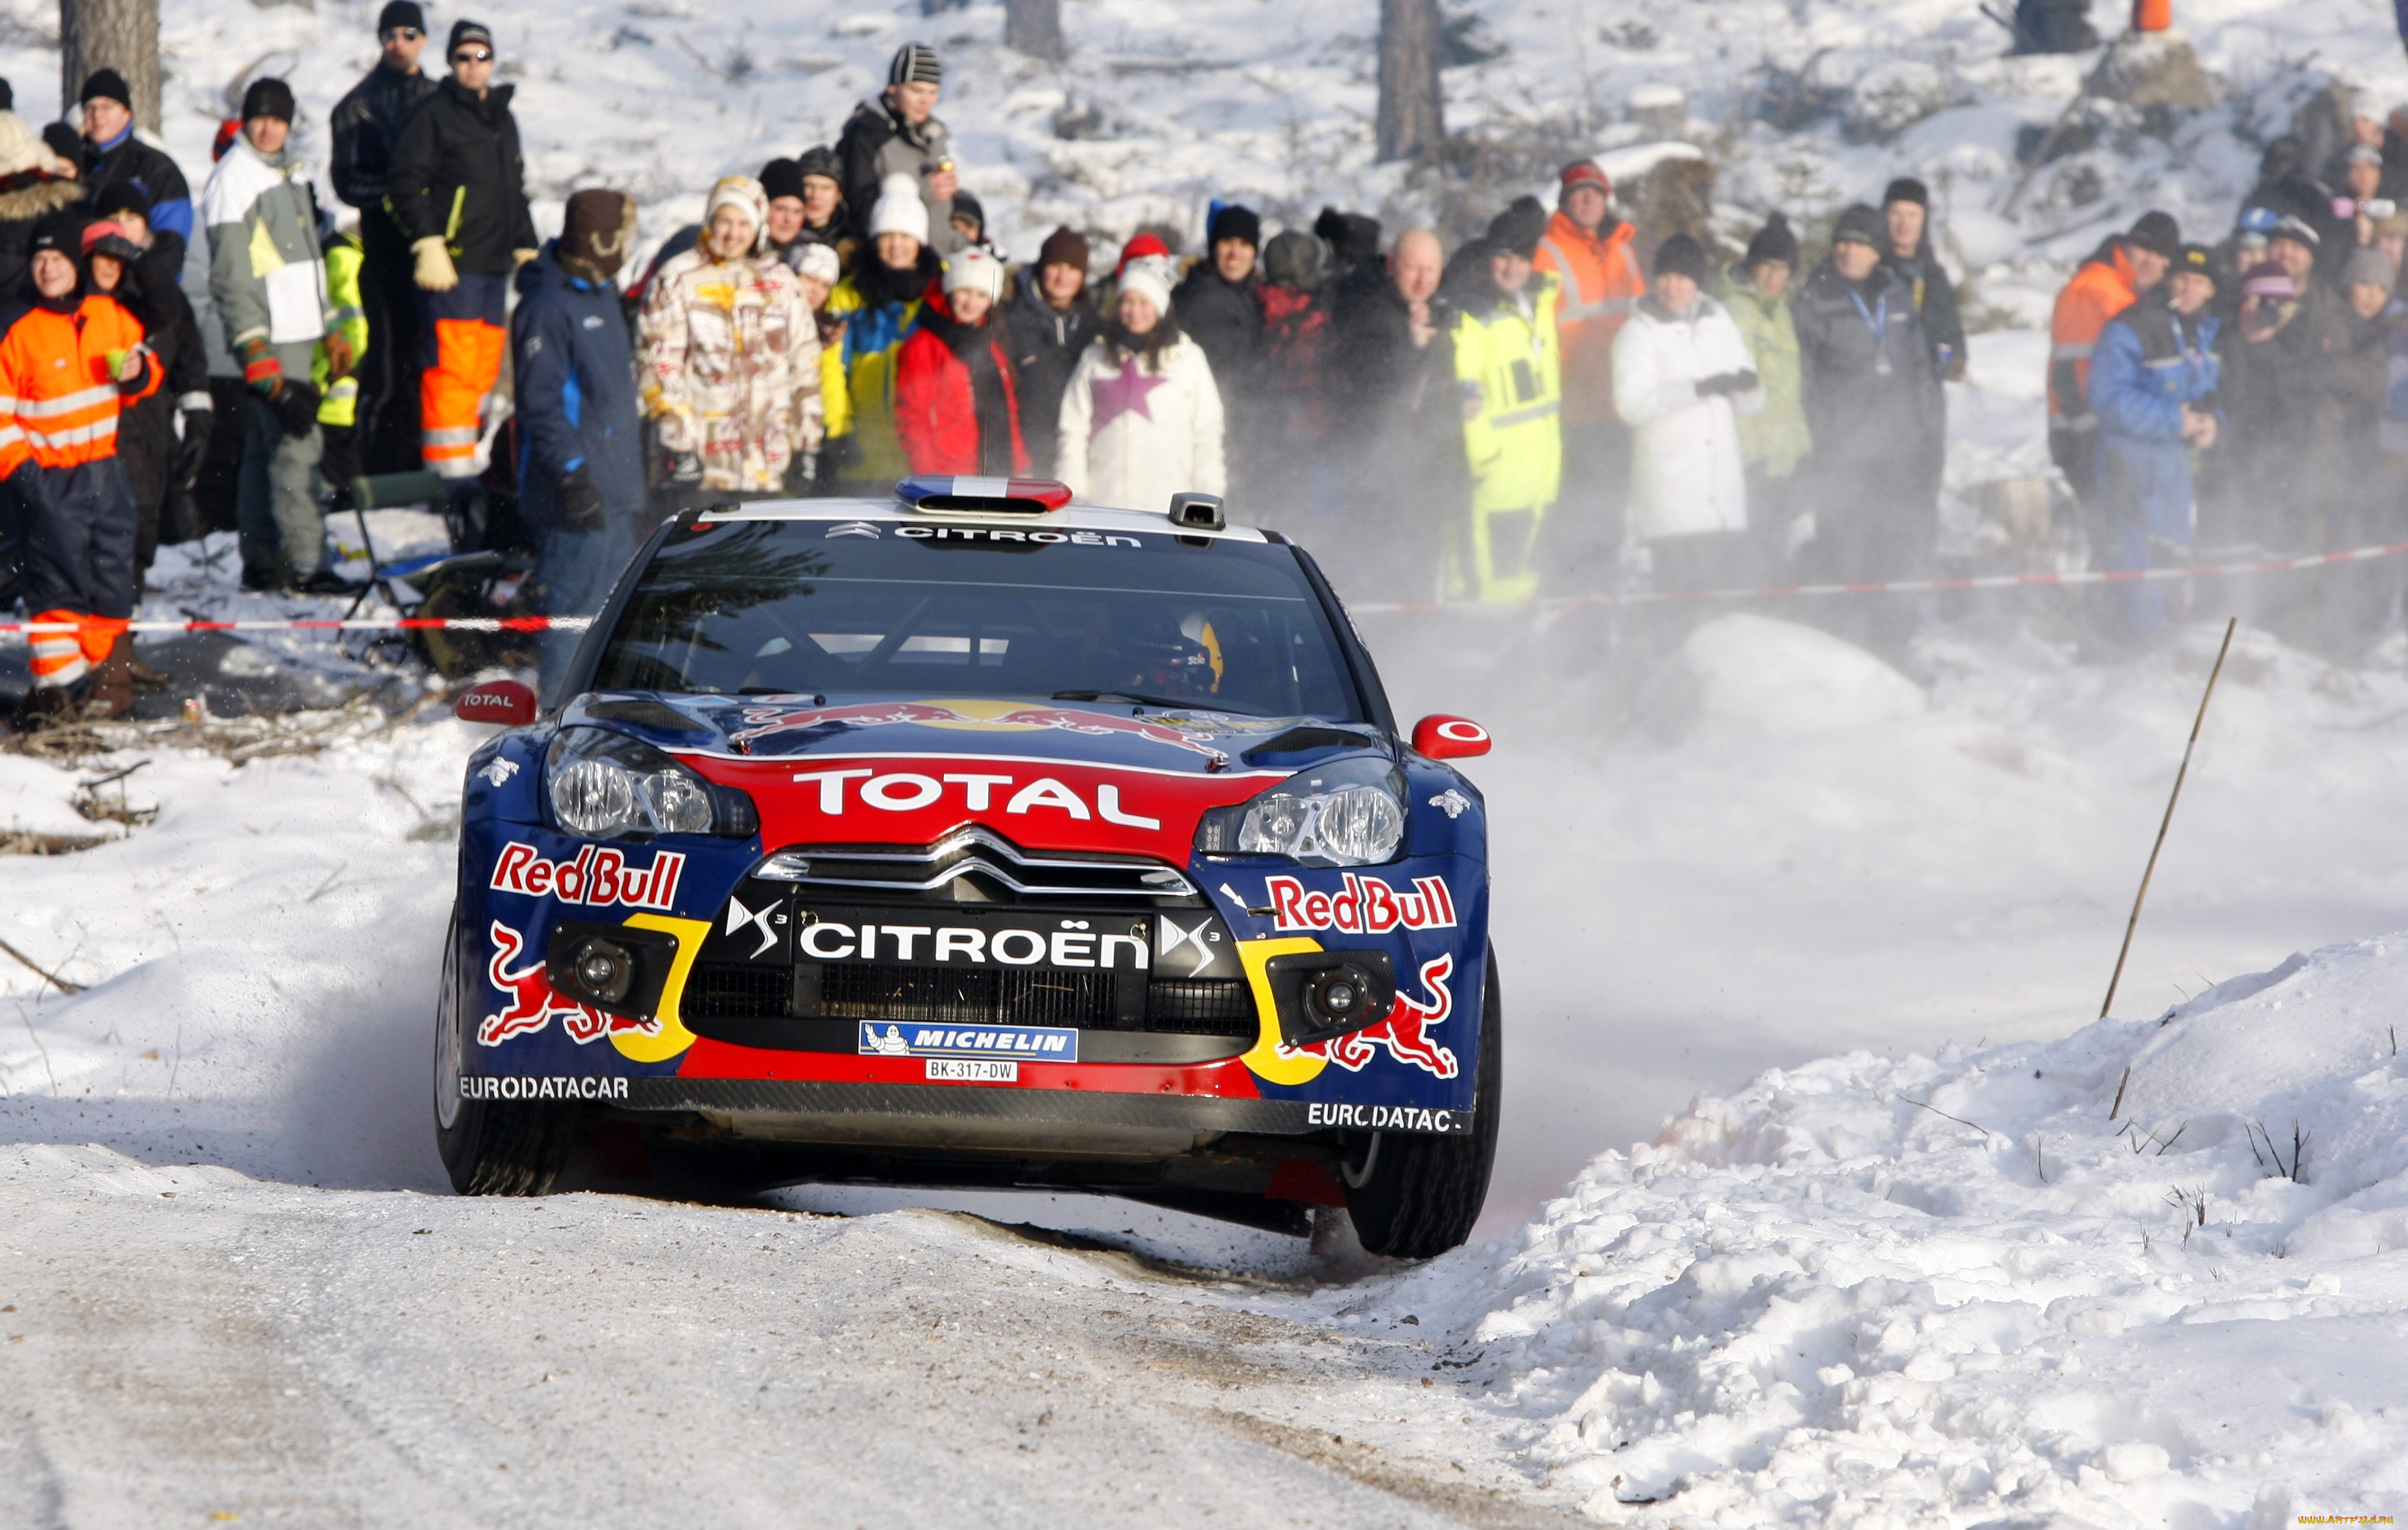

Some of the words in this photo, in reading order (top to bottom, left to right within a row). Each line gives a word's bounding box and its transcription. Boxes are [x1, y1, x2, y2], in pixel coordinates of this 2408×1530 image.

[464, 693, 514, 708] TOTAL
[793, 768, 1161, 831] TOTAL
[914, 1030, 1068, 1052] MICHELIN
[931, 1062, 1012, 1079] BK-317-DW
[460, 1076, 629, 1099] EURODATACAR
